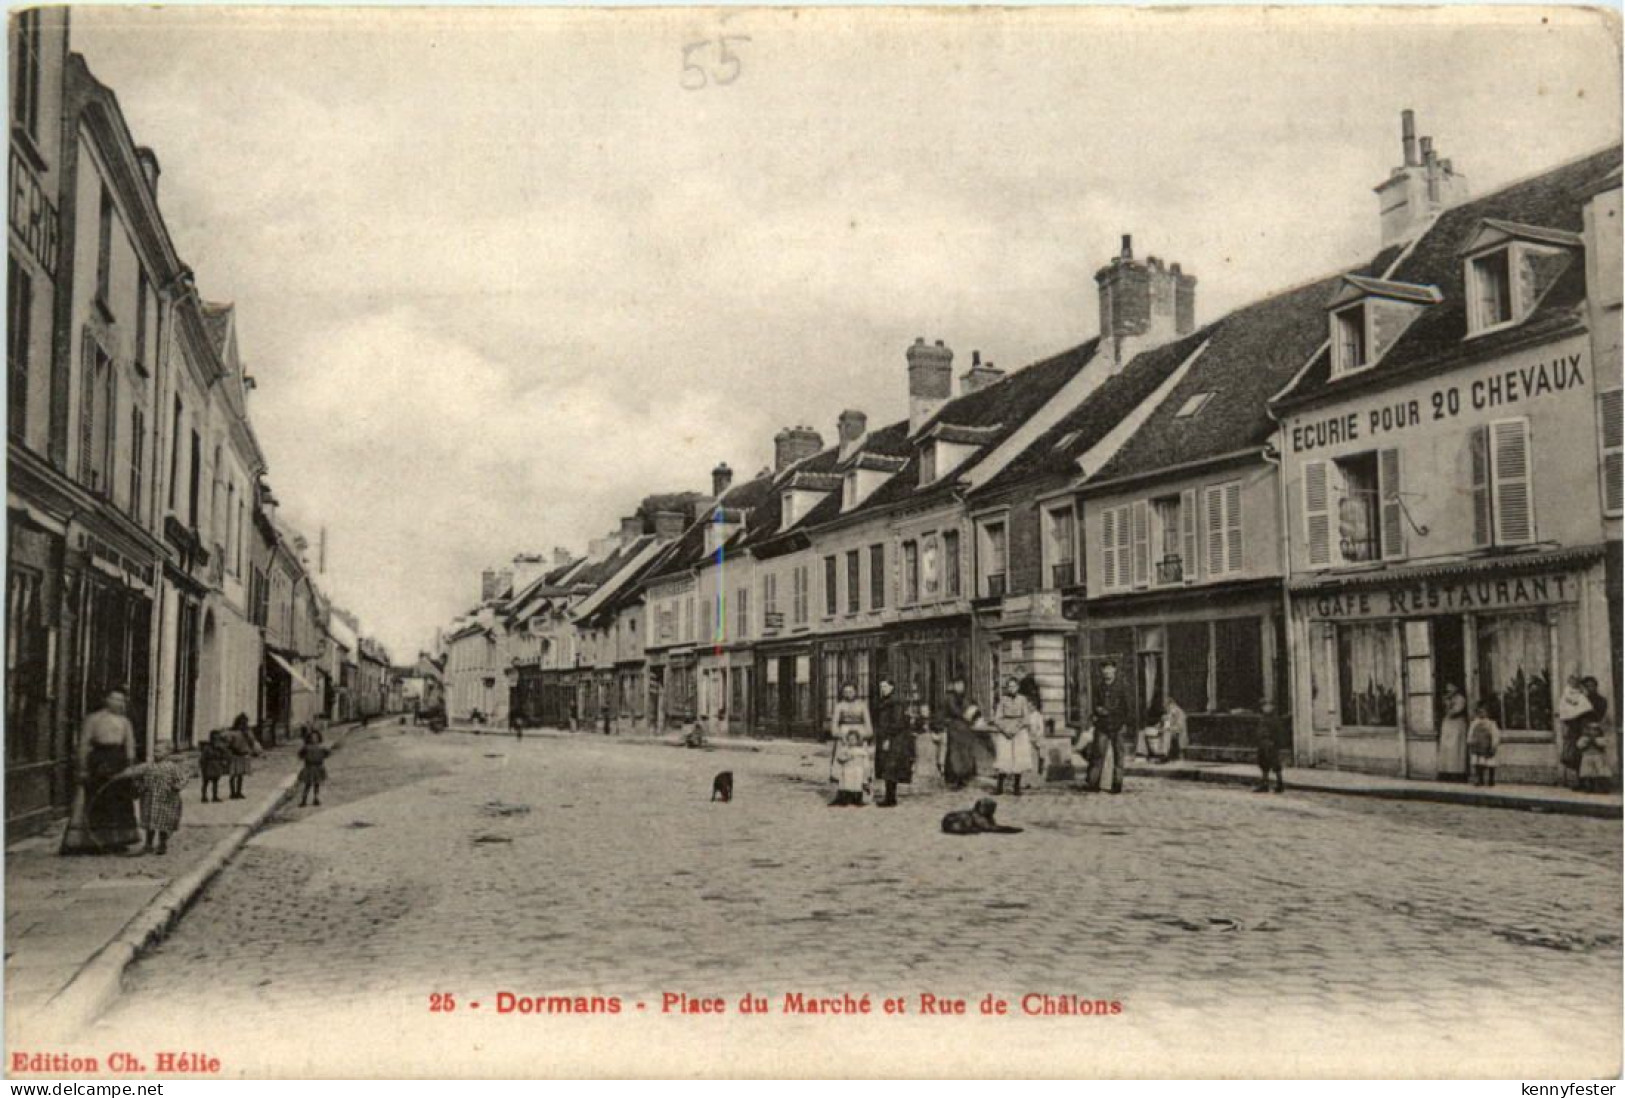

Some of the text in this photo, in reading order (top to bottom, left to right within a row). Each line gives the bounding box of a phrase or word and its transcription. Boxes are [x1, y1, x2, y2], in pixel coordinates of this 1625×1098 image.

[679, 35, 752, 90] 55
[1293, 353, 1585, 453] ÉCURIE POUR 20 CHEVAUX
[1387, 576, 1567, 614] RESTAURANT
